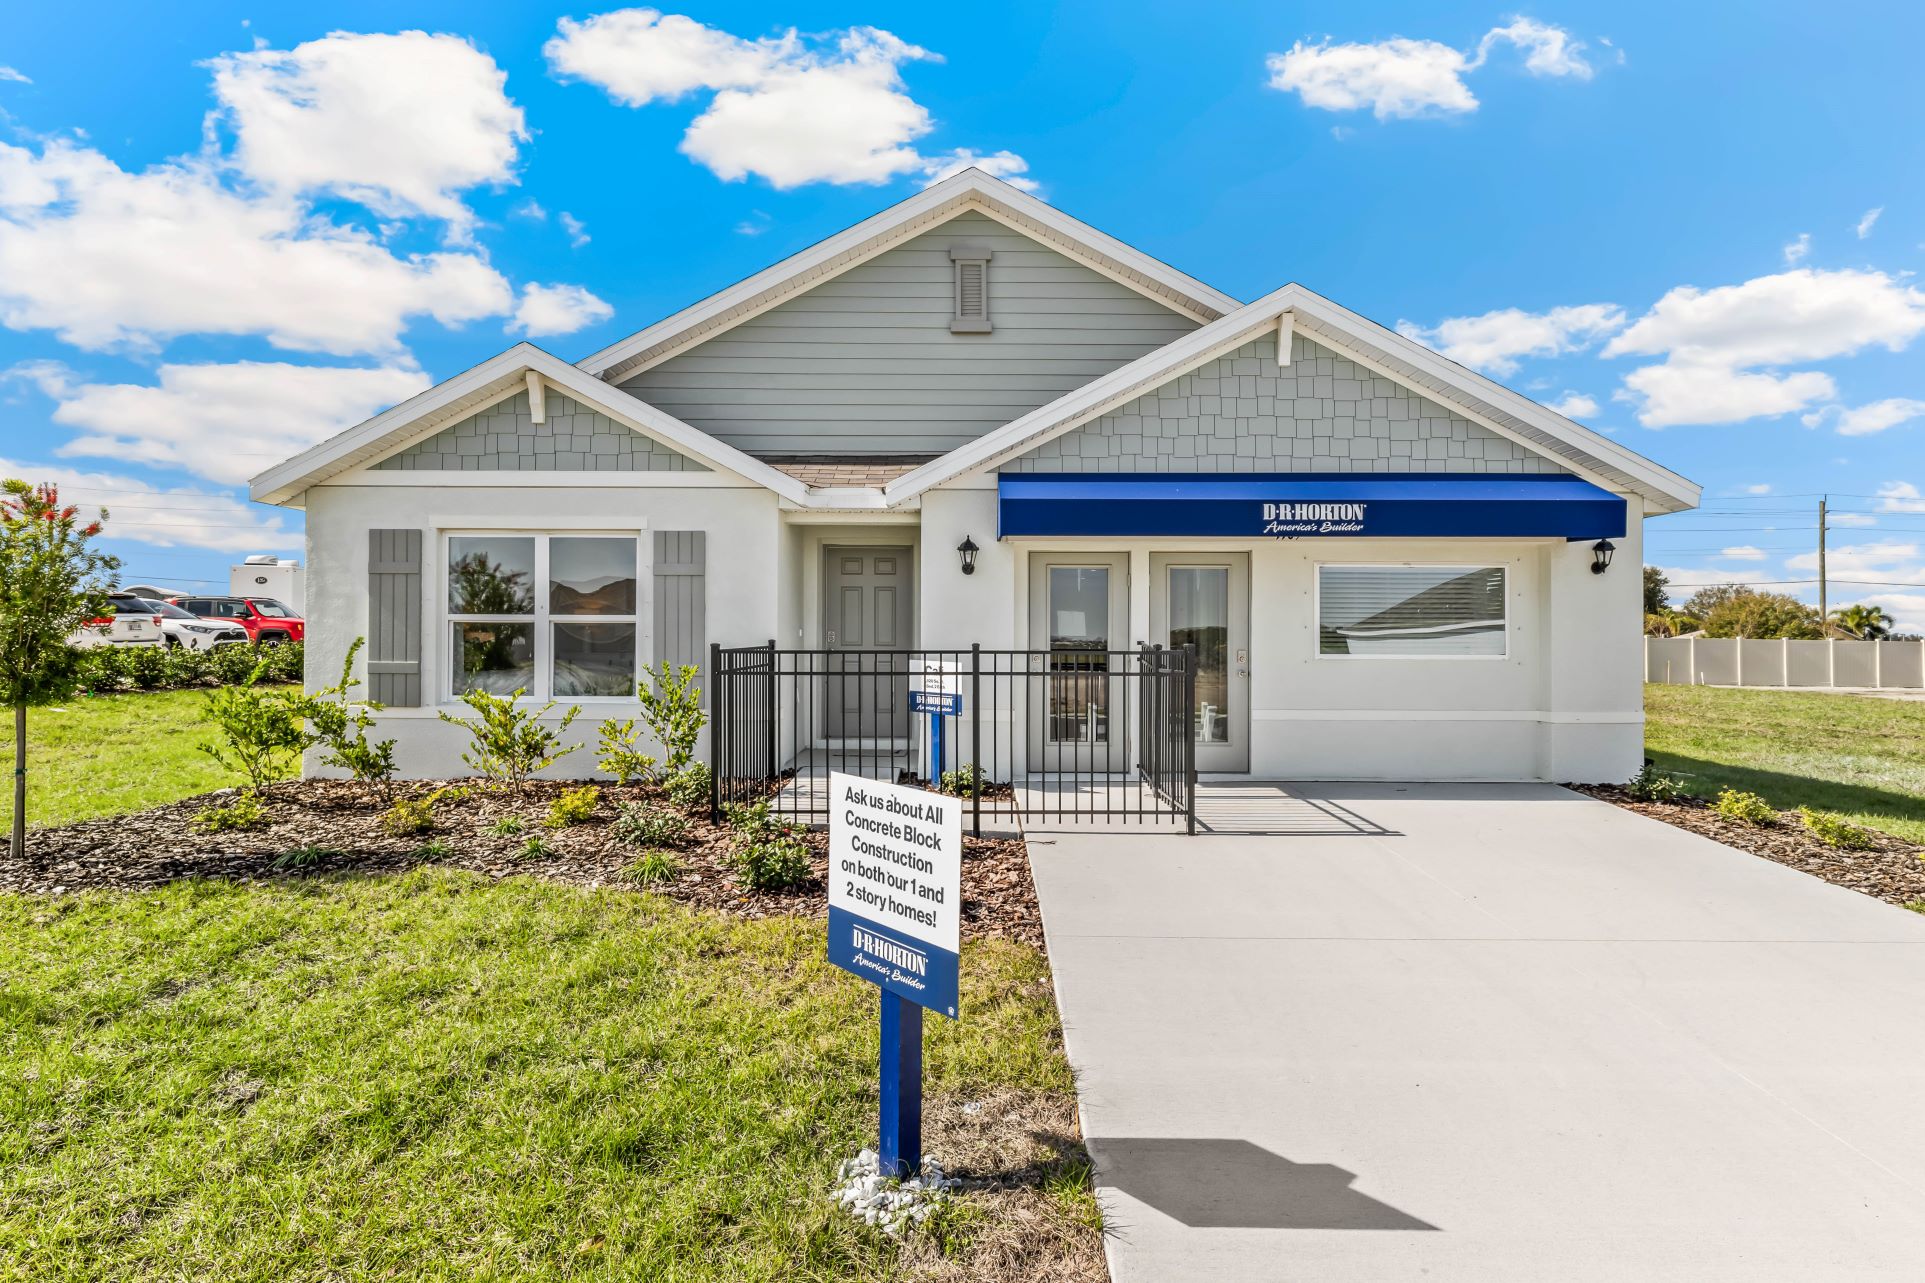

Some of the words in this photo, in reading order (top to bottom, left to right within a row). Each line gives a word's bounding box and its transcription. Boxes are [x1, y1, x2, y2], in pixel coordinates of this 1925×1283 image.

[1263, 521, 1318, 533] America's
[1319, 521, 1364, 533] Builder
[845, 786, 868, 806] Ask
[869, 795, 884, 810] us
[886, 796, 923, 820] about
[925, 805, 943, 825] All
[845, 809, 901, 839] Concrete
[903, 824, 942, 852] Block
[851, 835, 933, 875] Construction
[841, 859, 856, 874] on
[858, 860, 885, 884] both
[887, 874, 909, 891] our
[911, 878, 916, 895] 1
[918, 886, 944, 905] and
[846, 881, 854, 897] 2
[855, 886, 887, 912] story
[888, 895, 936, 928] homes!
[852, 952, 890, 975] America's
[891, 969, 926, 990] Builder
